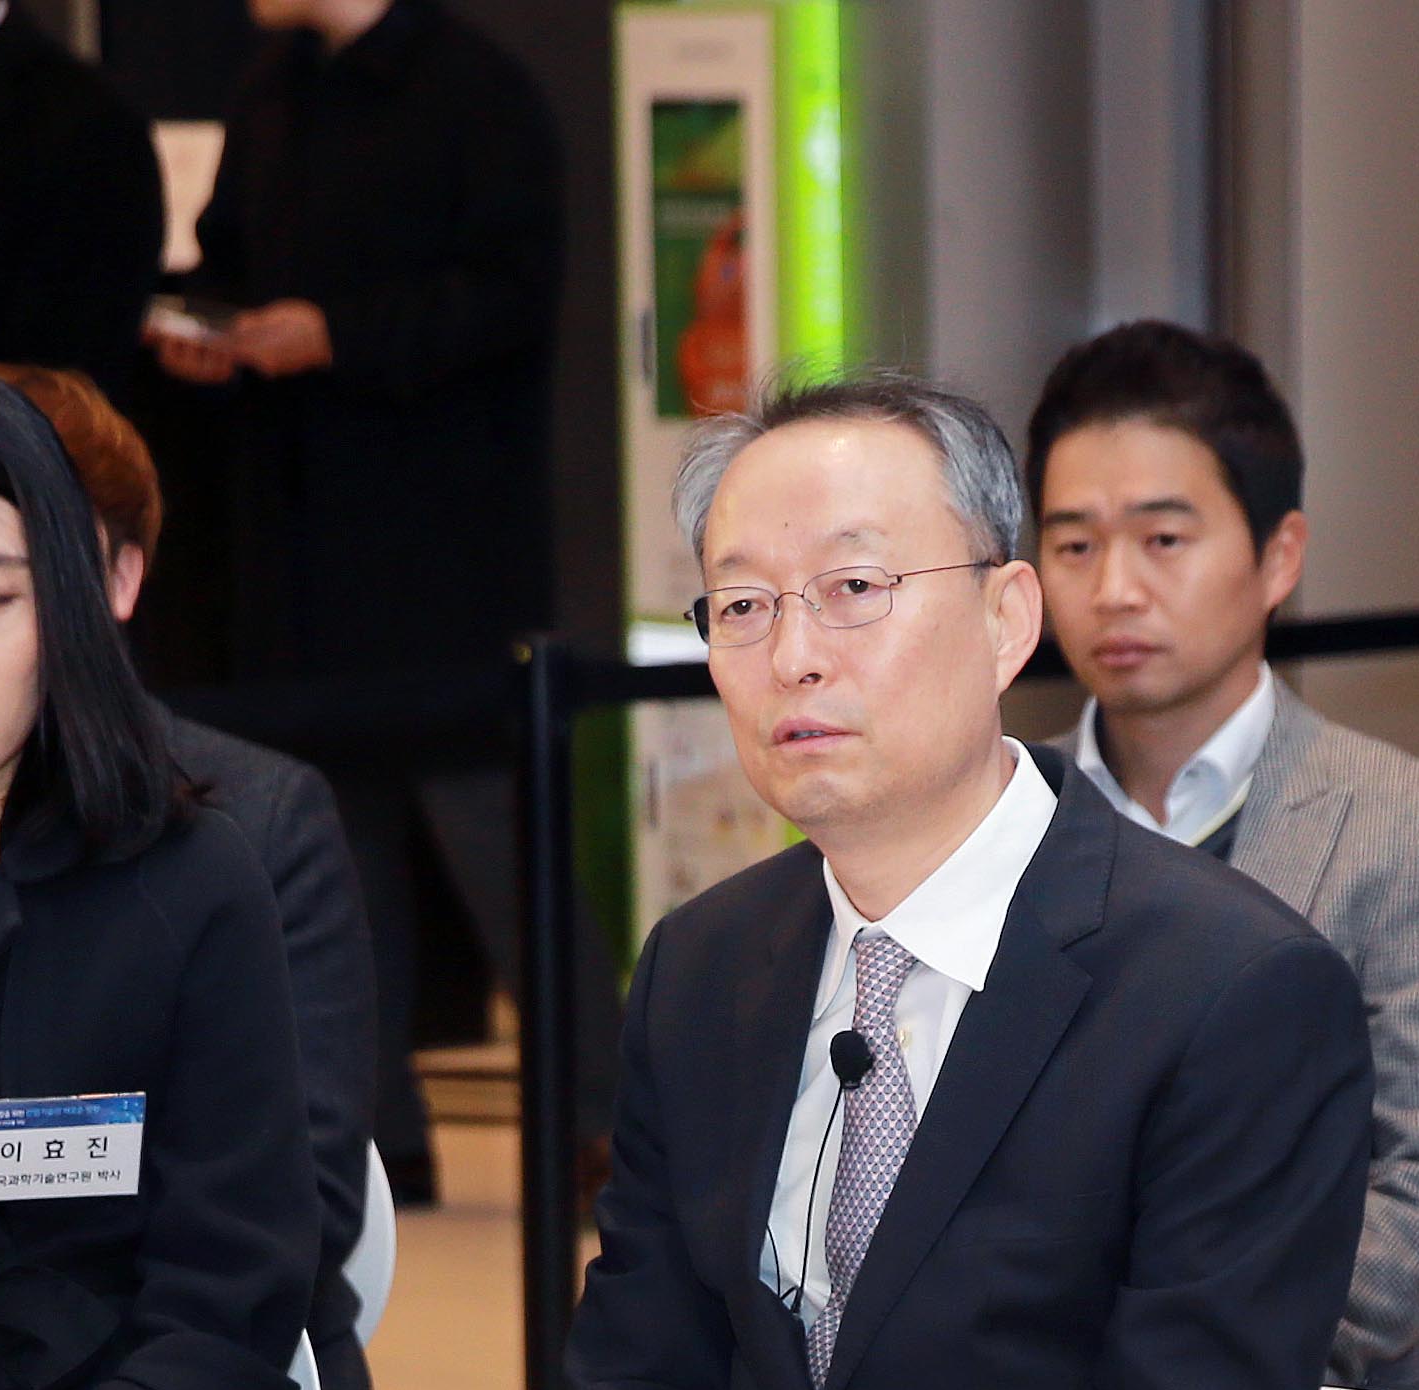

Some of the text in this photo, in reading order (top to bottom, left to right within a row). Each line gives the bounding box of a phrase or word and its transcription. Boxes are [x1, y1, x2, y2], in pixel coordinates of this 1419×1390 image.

[0, 1136, 110, 1162] 이 효 진
[98, 1169, 121, 1182] 박사
